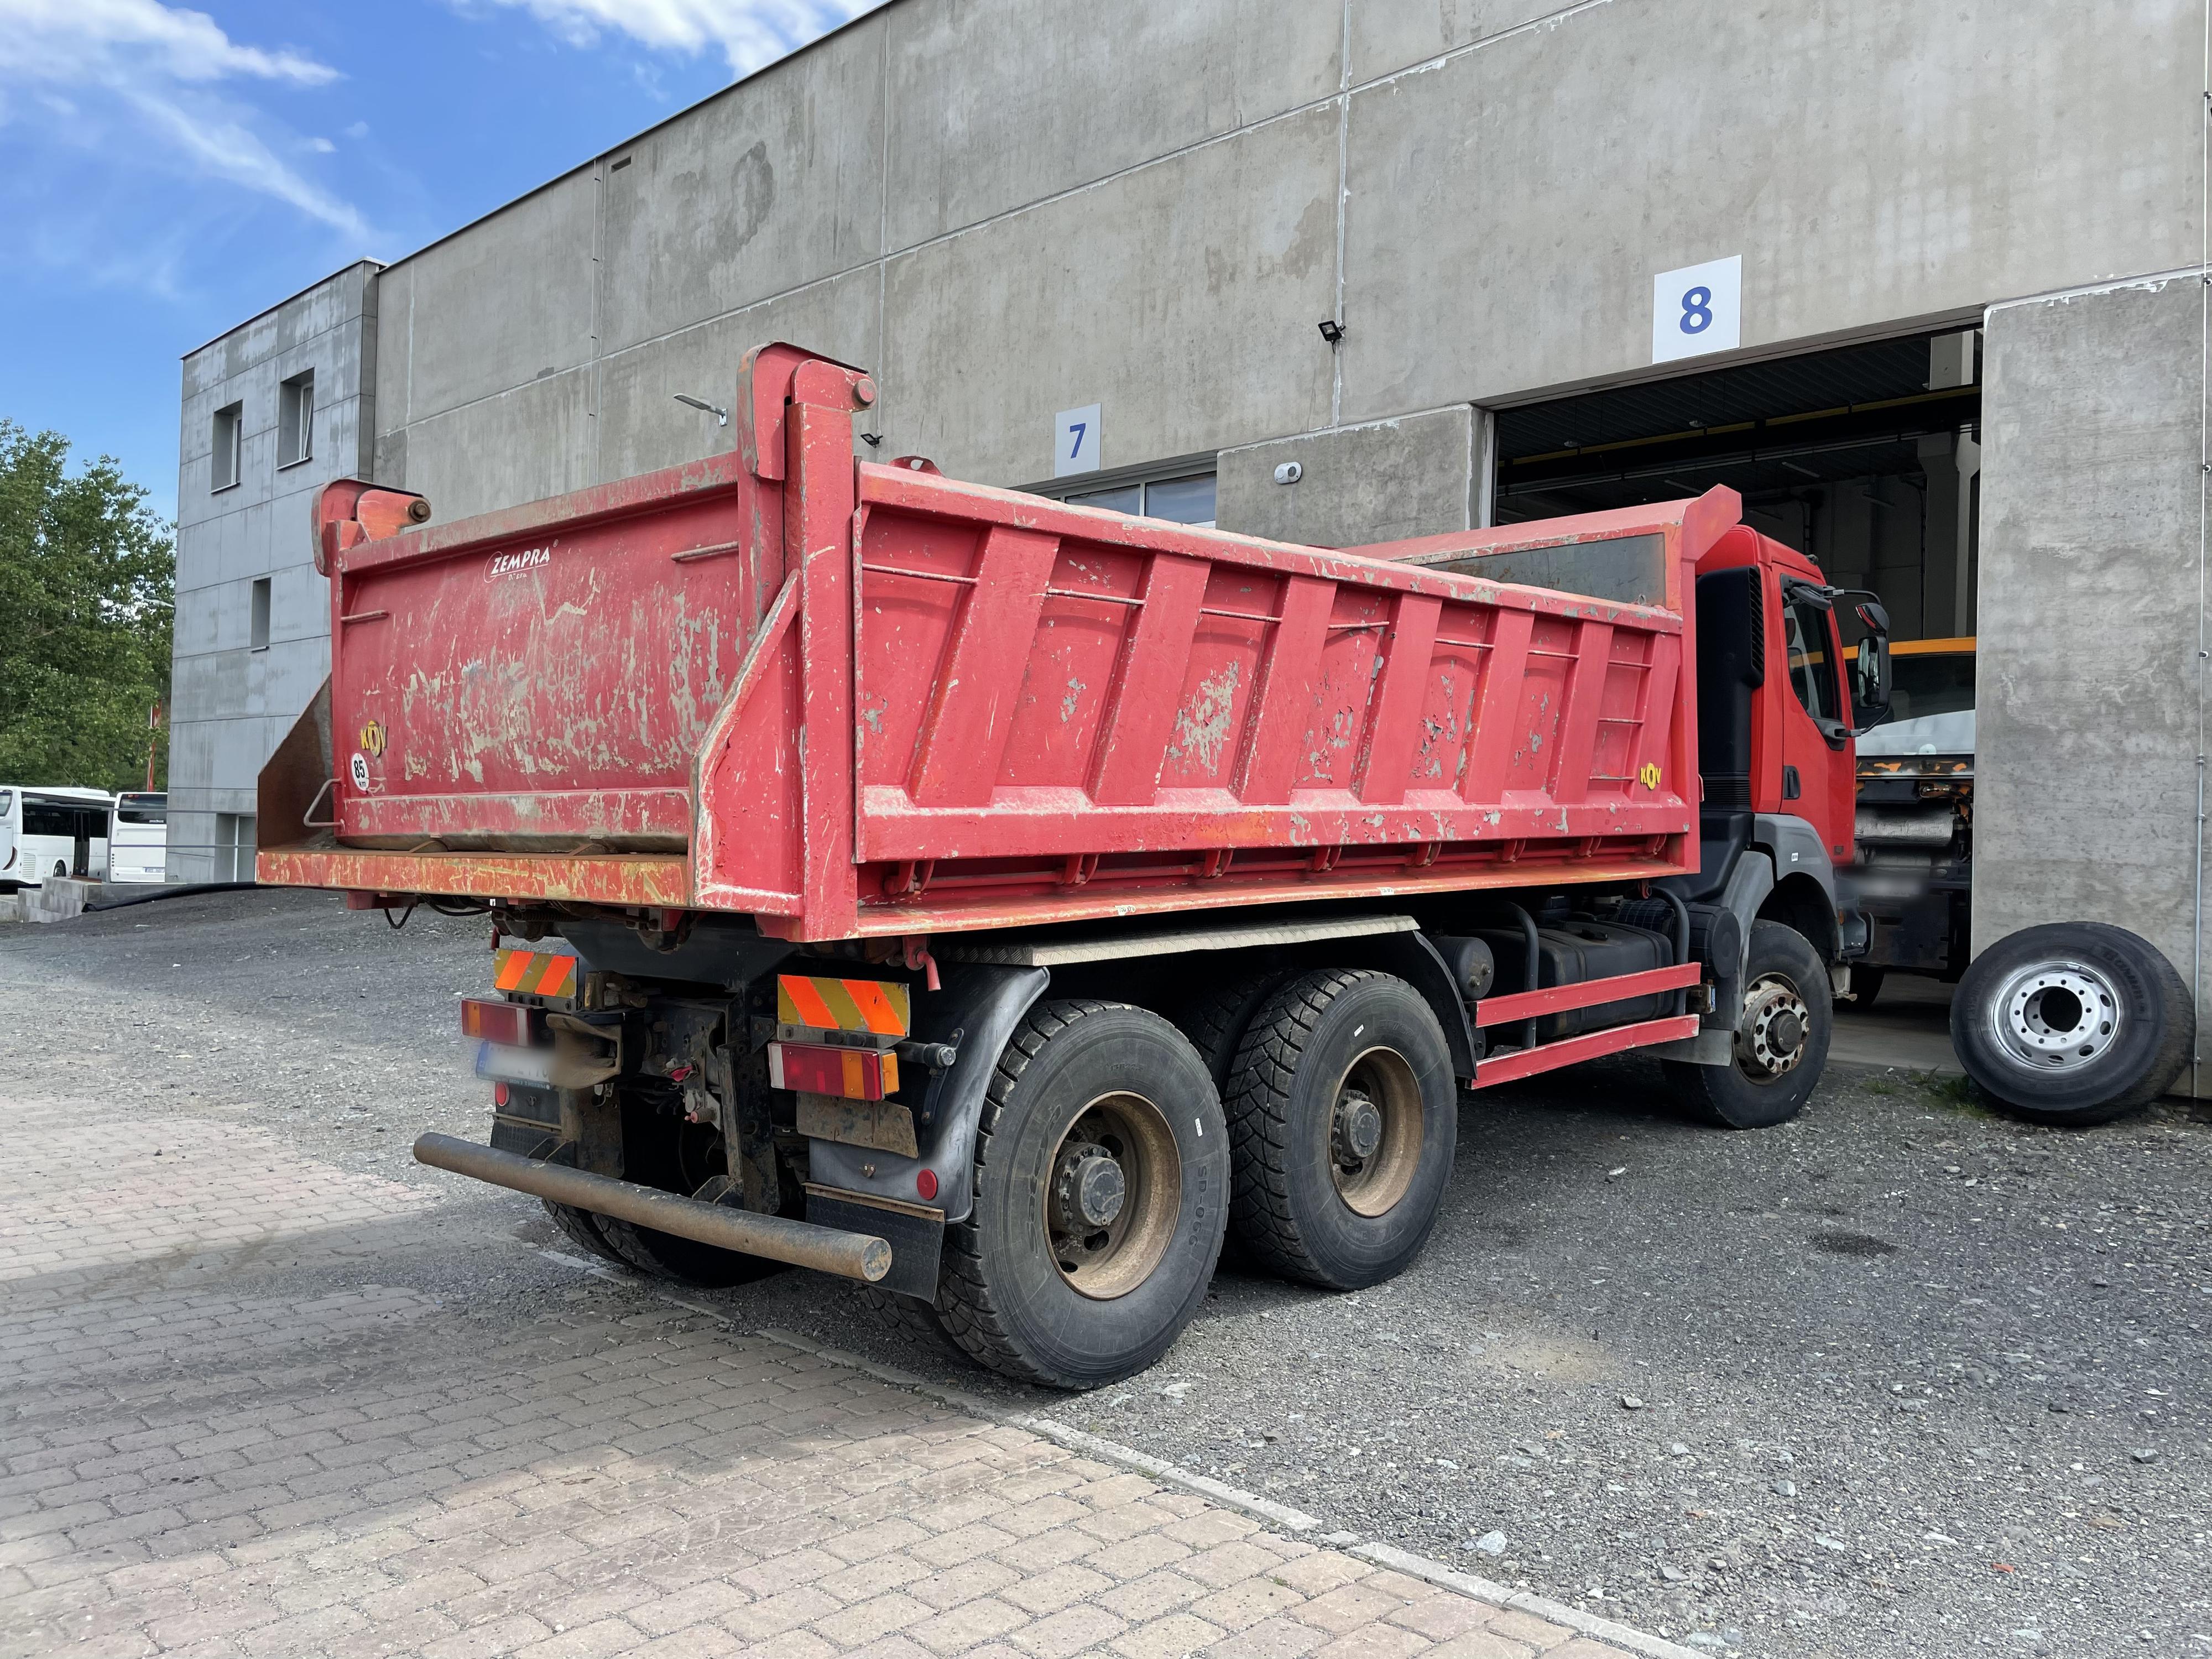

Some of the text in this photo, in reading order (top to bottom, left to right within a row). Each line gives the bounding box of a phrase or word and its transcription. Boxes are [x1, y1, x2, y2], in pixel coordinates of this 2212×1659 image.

[1679, 286, 1713, 335] 8
[1070, 422, 1086, 459] 7
[491, 546, 550, 575] ZEMPRA
[354, 760, 366, 779] 85
[1640, 762, 1661, 790] KOV
[1189, 1165, 1208, 1248] SD-066
